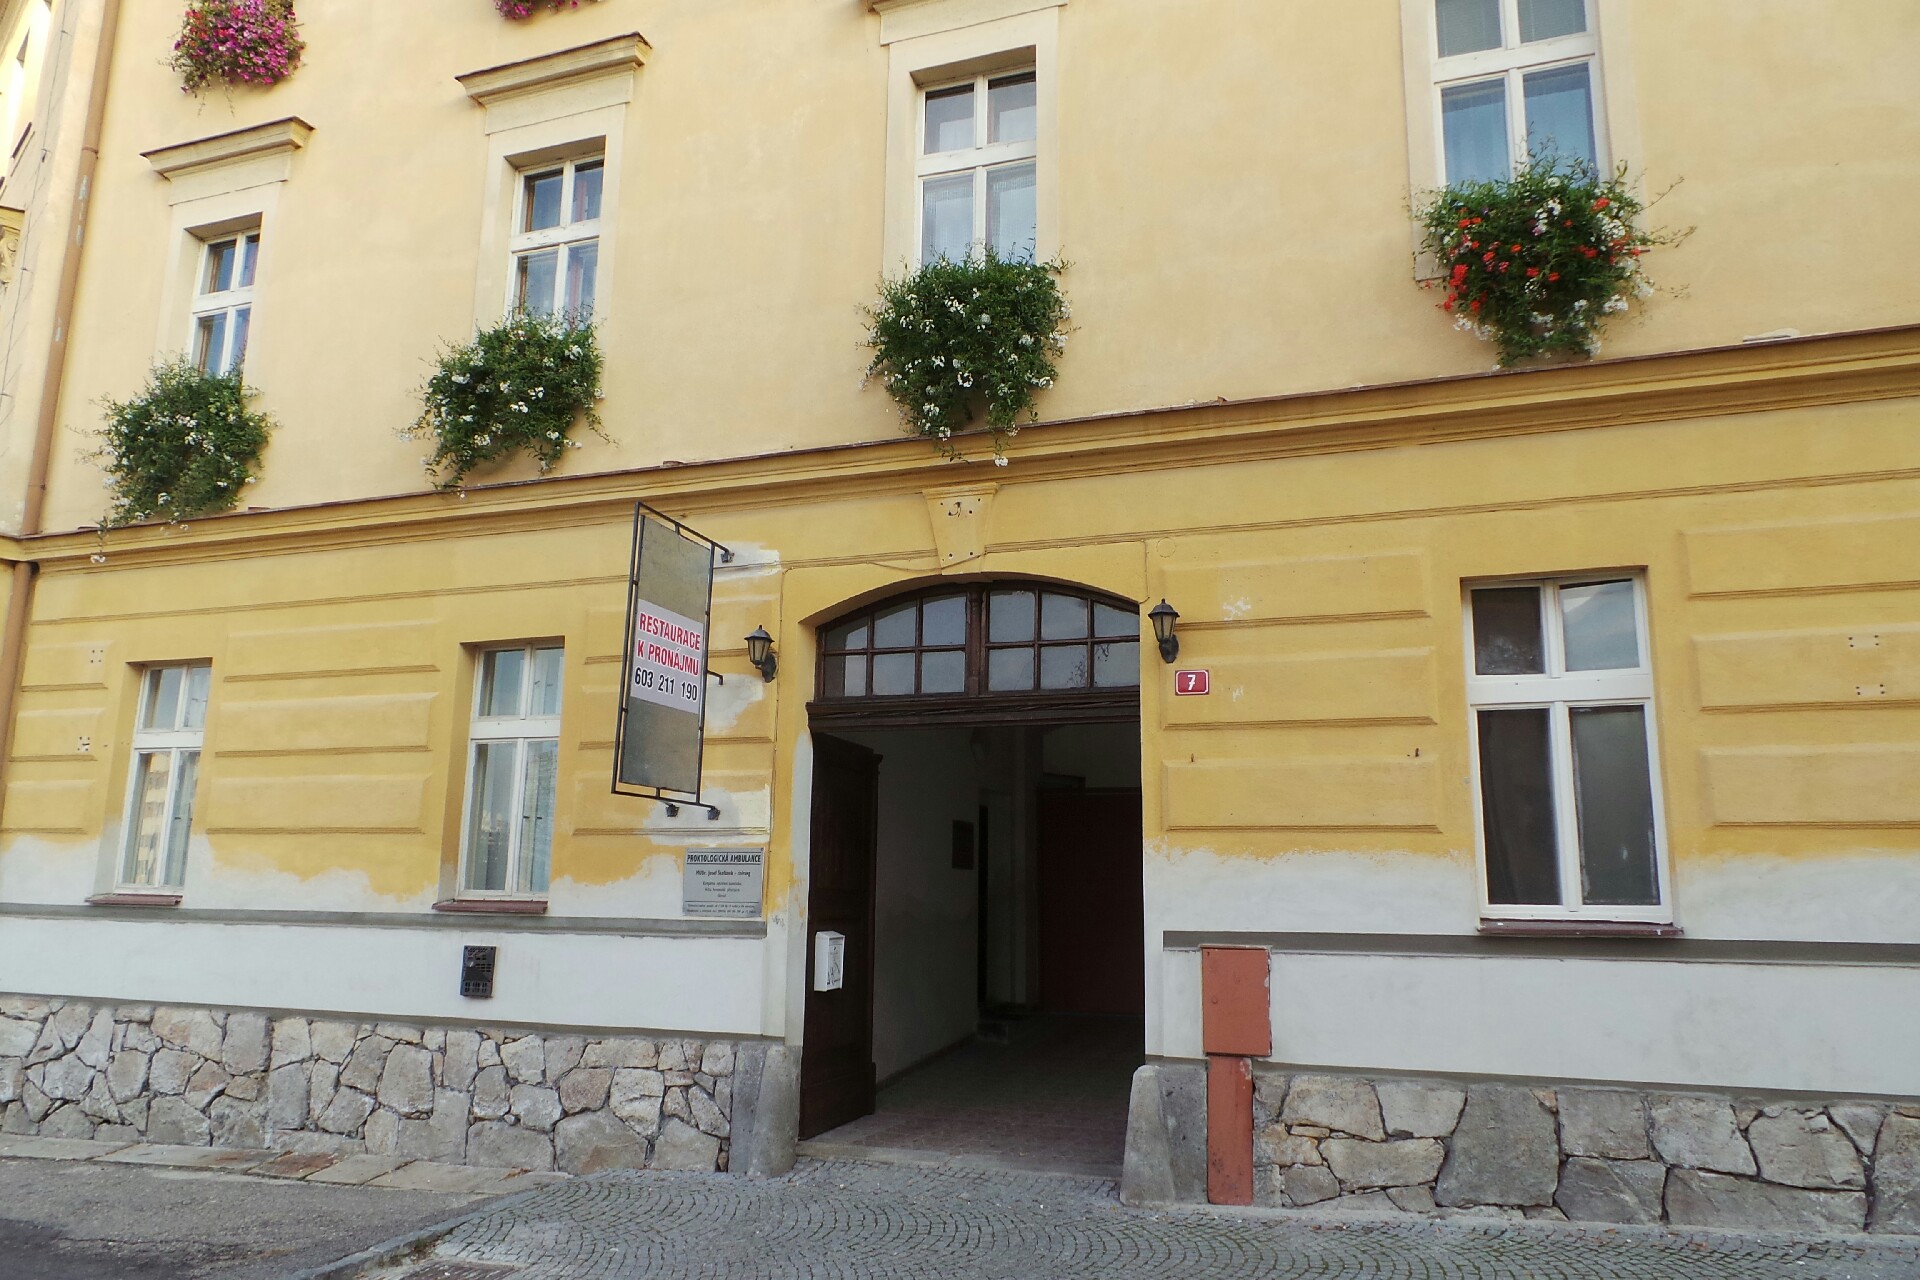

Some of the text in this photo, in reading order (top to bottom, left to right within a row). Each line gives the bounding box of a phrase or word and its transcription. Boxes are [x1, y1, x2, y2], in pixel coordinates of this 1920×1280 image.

[639, 612, 701, 651] RESTAURACE
[637, 639, 699, 676] K PRONÁJMU
[634, 667, 698, 701] 603 211 190
[1187, 674, 1196, 691] 7
[730, 854, 761, 863] AMBULANCE
